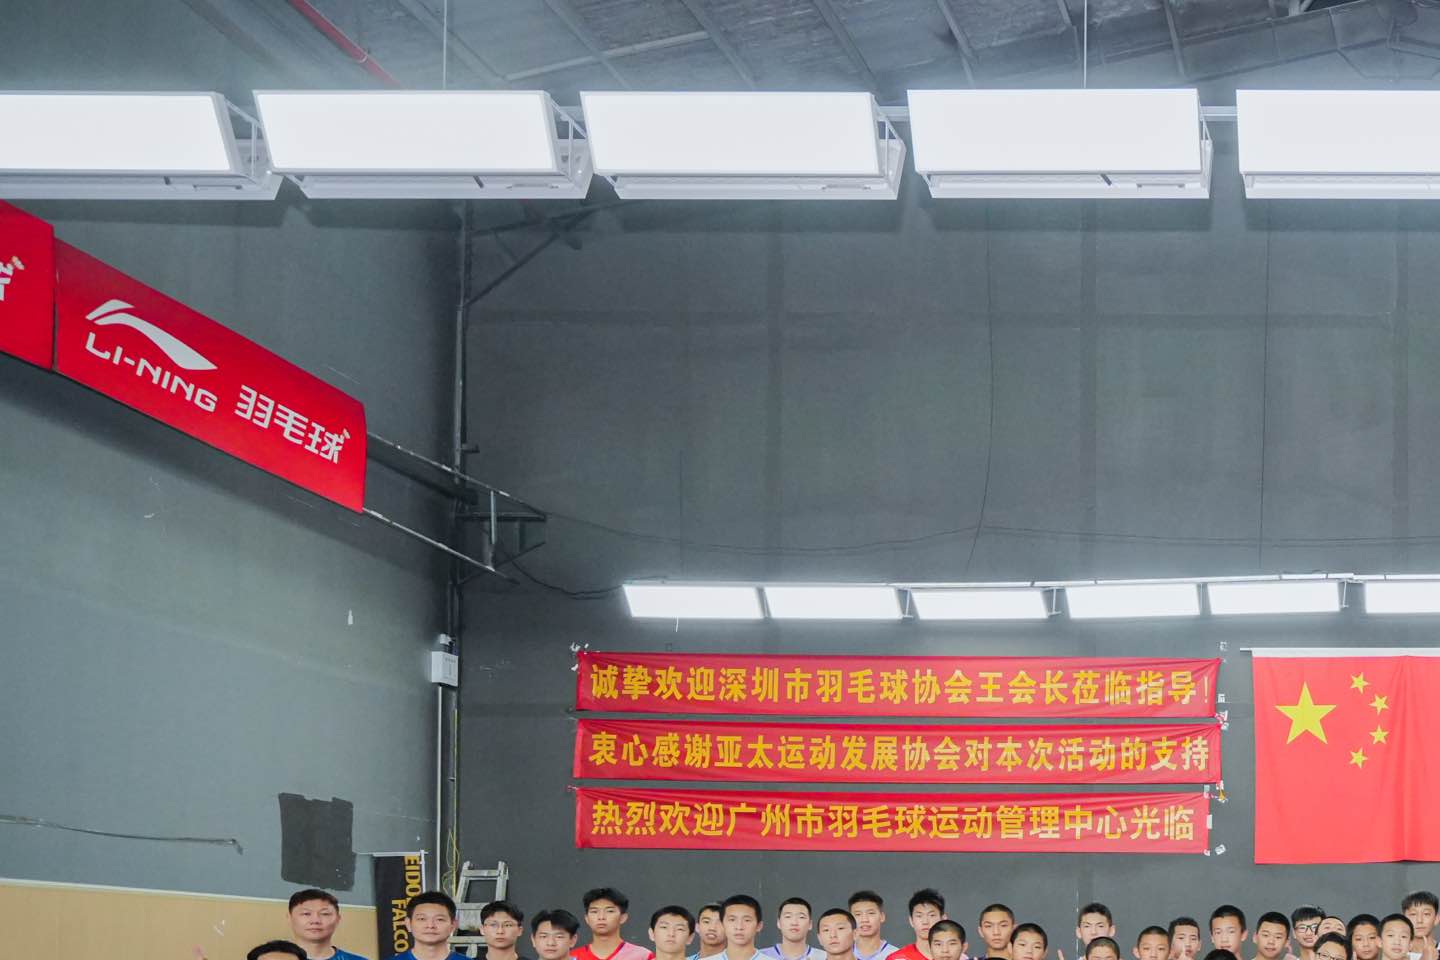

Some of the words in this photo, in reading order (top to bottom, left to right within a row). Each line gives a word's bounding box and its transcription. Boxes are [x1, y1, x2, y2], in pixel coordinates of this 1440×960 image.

[85, 332, 218, 413] LI-NING
[234, 384, 351, 464] 羽毛球
[588, 731, 1209, 772] 衷心感谢亚太运动发展协会对本次活动的支持
[591, 800, 1195, 841] 热烈欢迎广州市羽毛球运动管理中心光临
[404, 855, 422, 898] EIDO
[392, 899, 409, 954] FALCO
